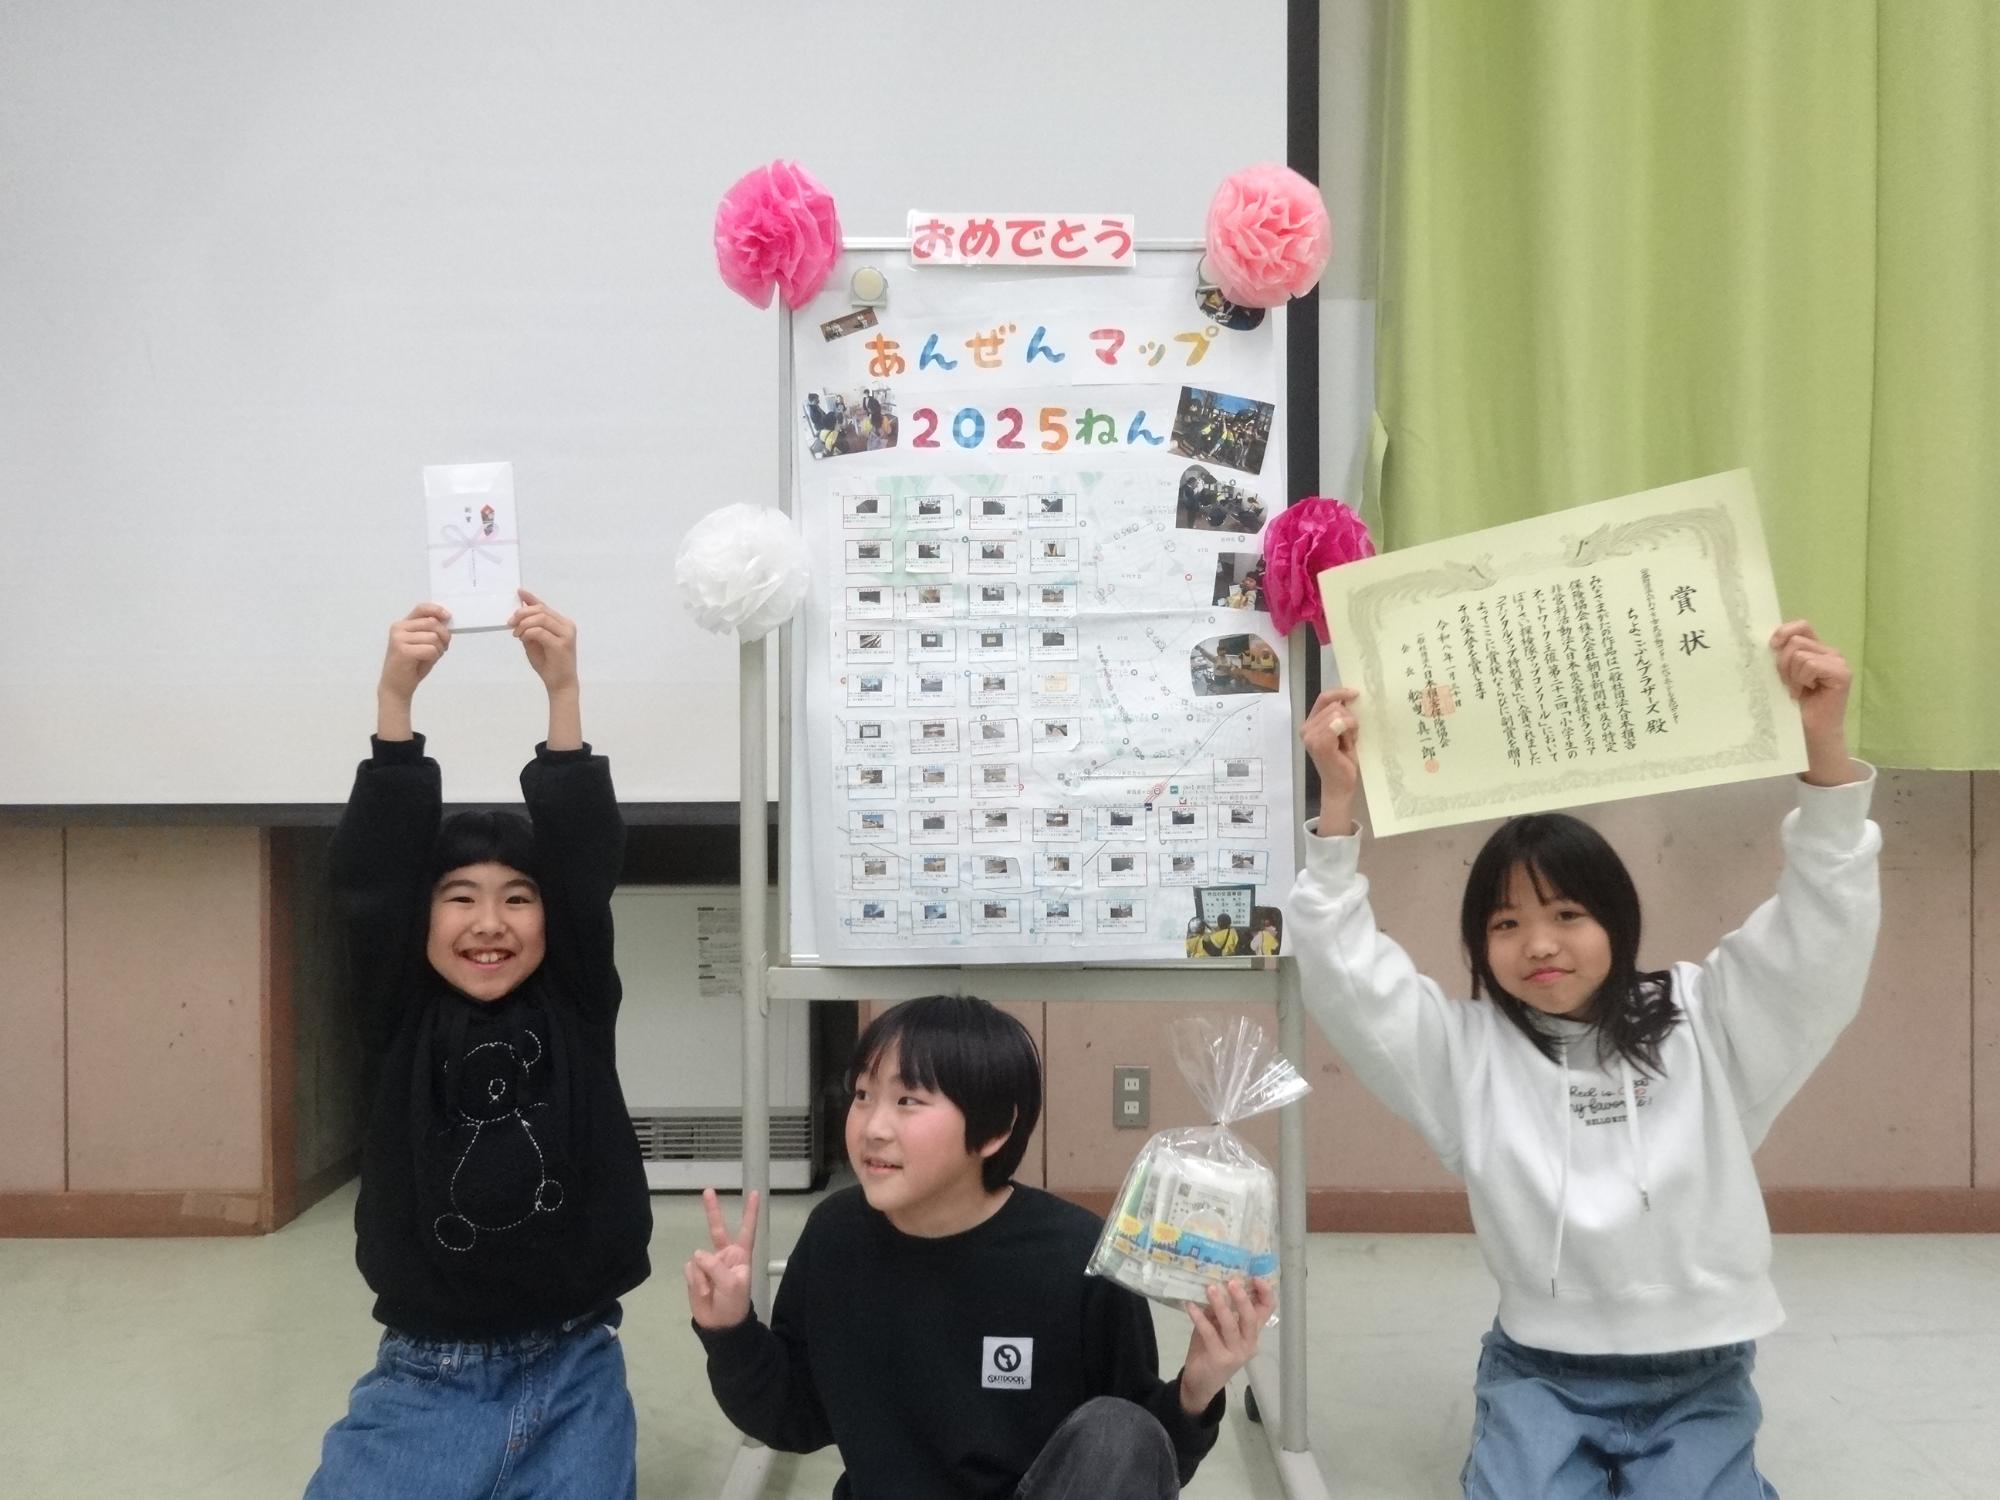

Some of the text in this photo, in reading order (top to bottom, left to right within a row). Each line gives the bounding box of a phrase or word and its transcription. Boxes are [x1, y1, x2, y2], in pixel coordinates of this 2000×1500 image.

[912, 218, 1132, 260] おめでとう
[912, 406, 1165, 451] 2025ねん
[1670, 585, 1712, 657] 賞状
